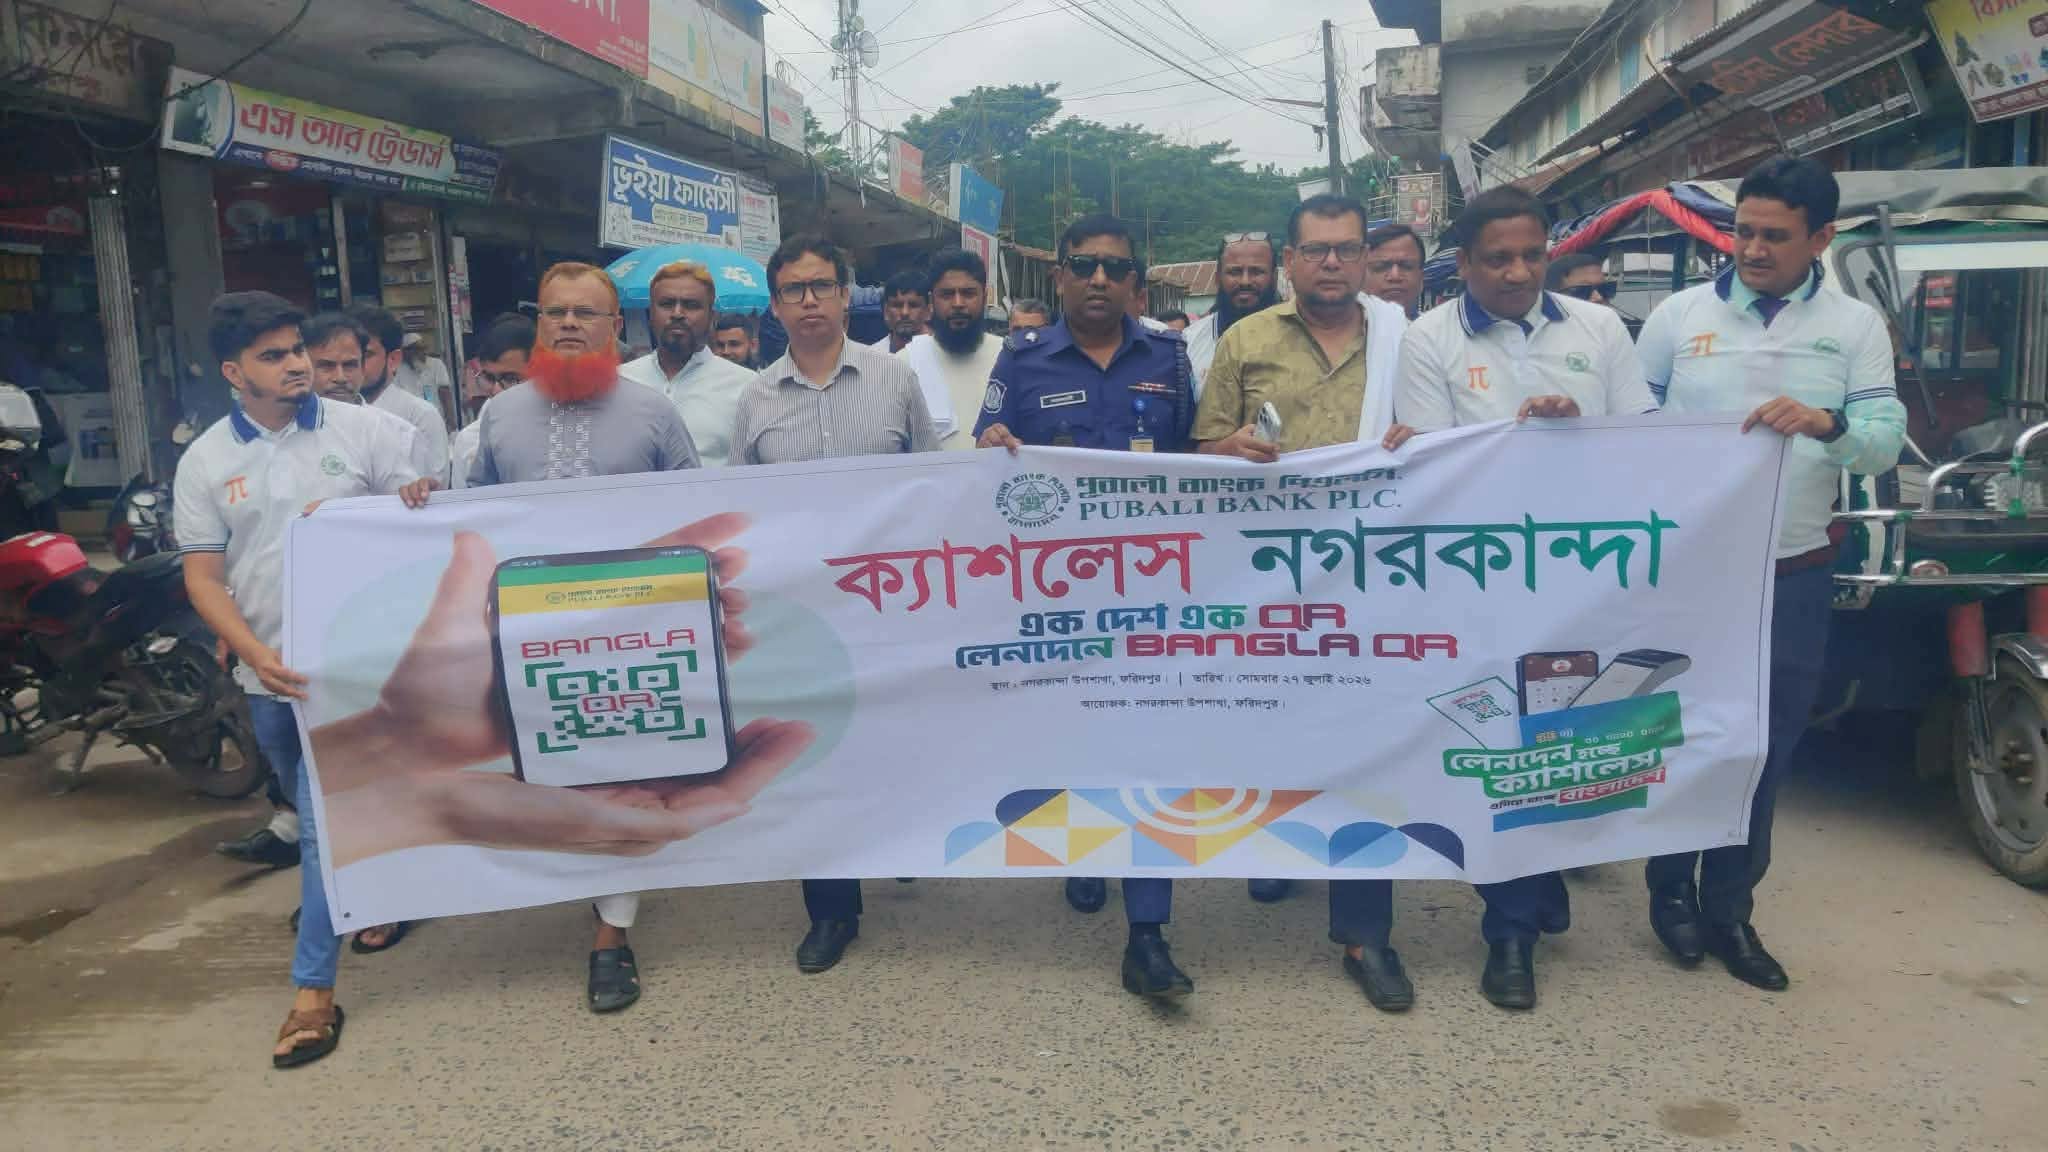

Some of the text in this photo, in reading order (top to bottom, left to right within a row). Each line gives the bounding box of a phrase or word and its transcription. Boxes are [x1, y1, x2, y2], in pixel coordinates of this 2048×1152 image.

[241, 103, 296, 140] এস
[302, 115, 368, 154] আর
[367, 125, 449, 169] ট্রেডার্স
[673, 174, 737, 214] ফার্মেসী
[1080, 488, 1402, 520] PUBALI BANK PLC.
[823, 508, 1681, 613] ক্যাশলেস নগরকান্দা
[1018, 602, 1347, 637] এক দেশ এক QR
[520, 627, 697, 660] BANGLA
[955, 632, 1459, 669] লেনদেনে BANGLA QR
[1282, 674, 1300, 686] ২৭
[581, 691, 657, 714] QR
[1450, 743, 1574, 773] লেনদেন
[1490, 748, 1657, 794] ক্যাশলেস
